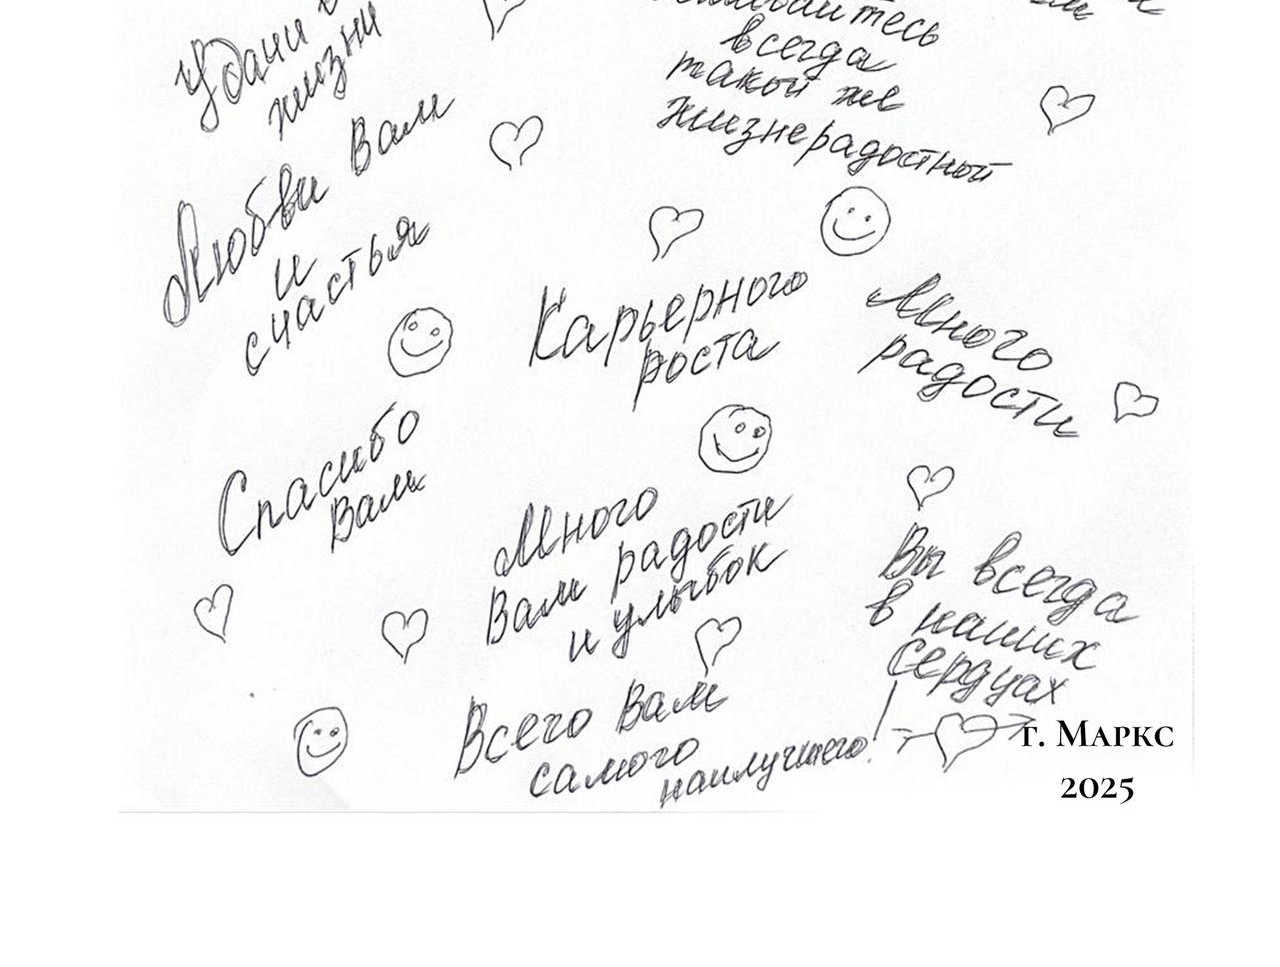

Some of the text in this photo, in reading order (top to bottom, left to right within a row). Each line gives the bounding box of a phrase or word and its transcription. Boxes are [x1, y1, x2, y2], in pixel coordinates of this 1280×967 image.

[174, 18, 309, 134] Удачи
[268, 0, 383, 142] жизни
[719, 12, 899, 81] всегда
[163, 163, 331, 328] Любви
[274, 254, 319, 301] и
[528, 270, 809, 368] Карьерного
[865, 272, 1054, 371] Много
[631, 328, 781, 413] роста
[856, 333, 1081, 439] радости
[217, 400, 421, 557] Спасибо
[493, 486, 659, 578] Много
[609, 493, 795, 605] радости
[877, 521, 1141, 626] Вы всегда
[568, 627, 602, 664] и
[864, 577, 1102, 671] в наших
[453, 695, 593, 780] Всего
[529, 737, 701, 798] самого
